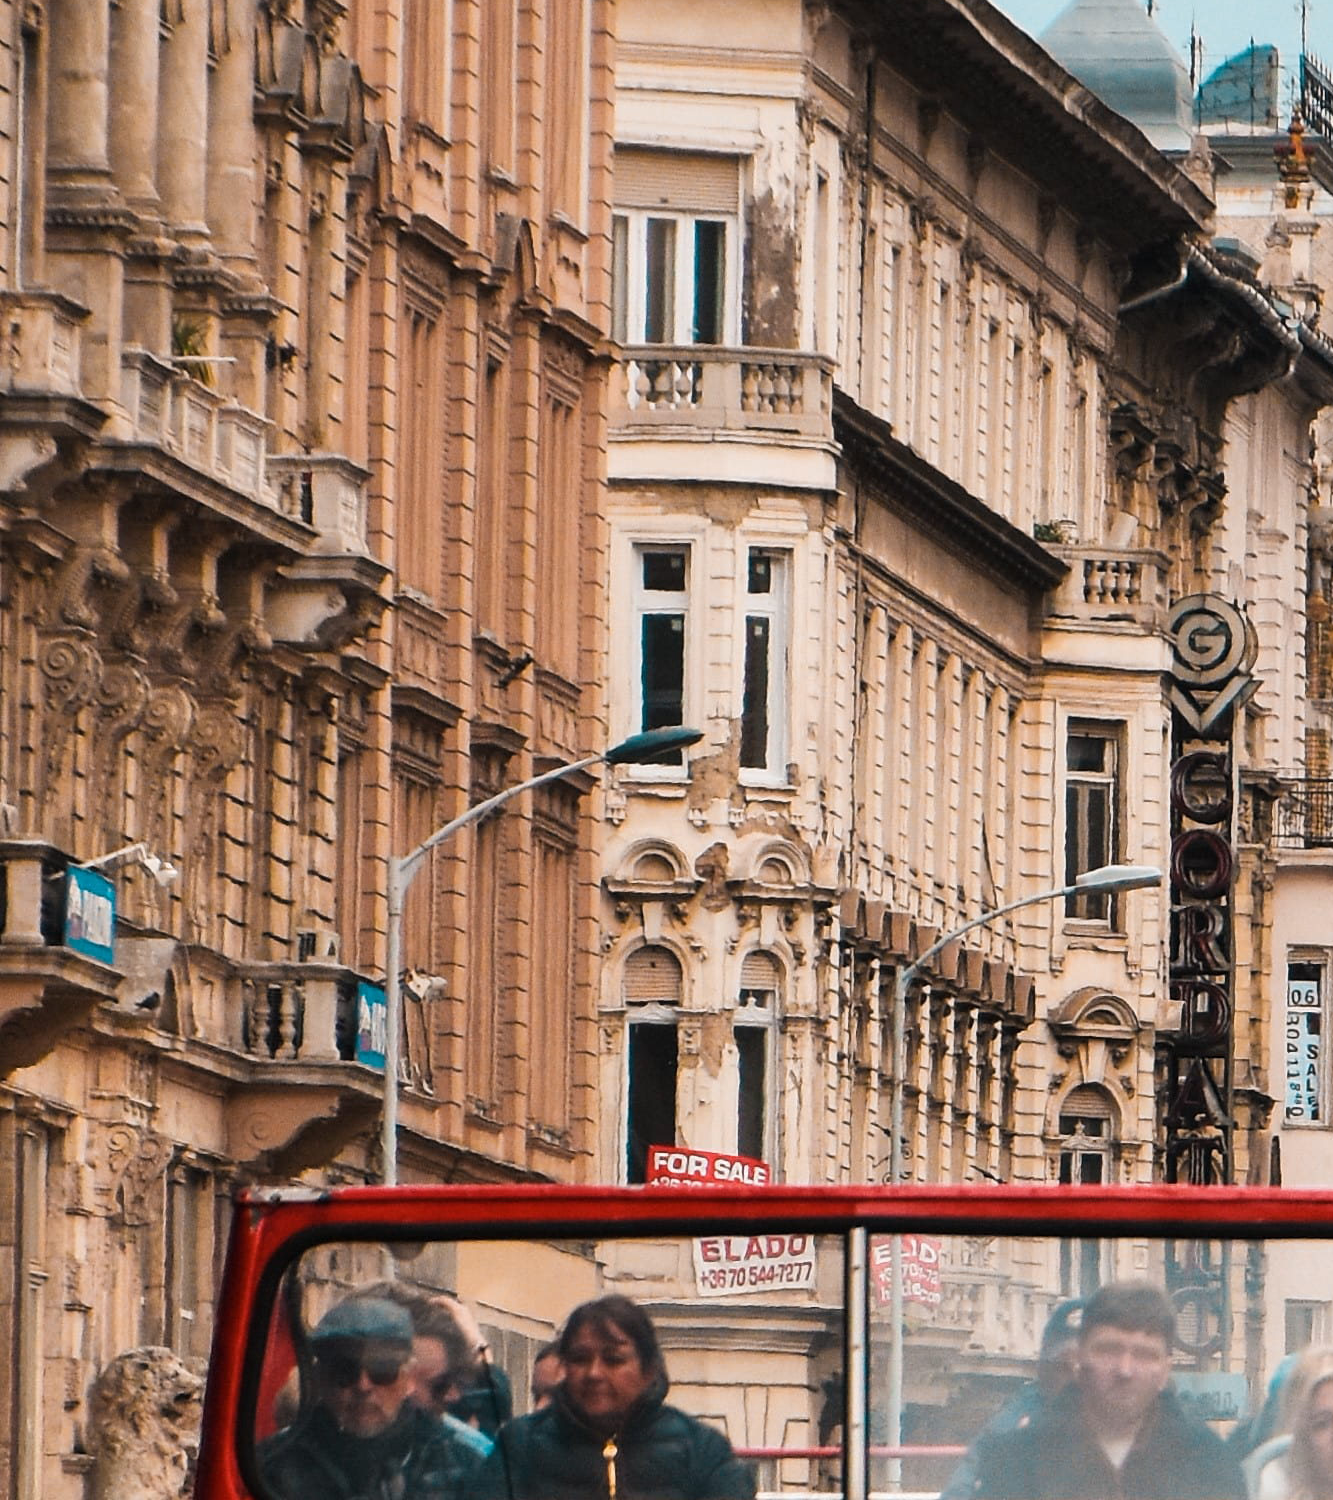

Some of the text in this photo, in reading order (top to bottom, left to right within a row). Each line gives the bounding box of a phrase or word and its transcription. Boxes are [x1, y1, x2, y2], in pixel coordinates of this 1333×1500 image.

[1291, 989, 1315, 1005] 06
[654, 1152, 708, 1177] FOR
[714, 1159, 767, 1187] SALE
